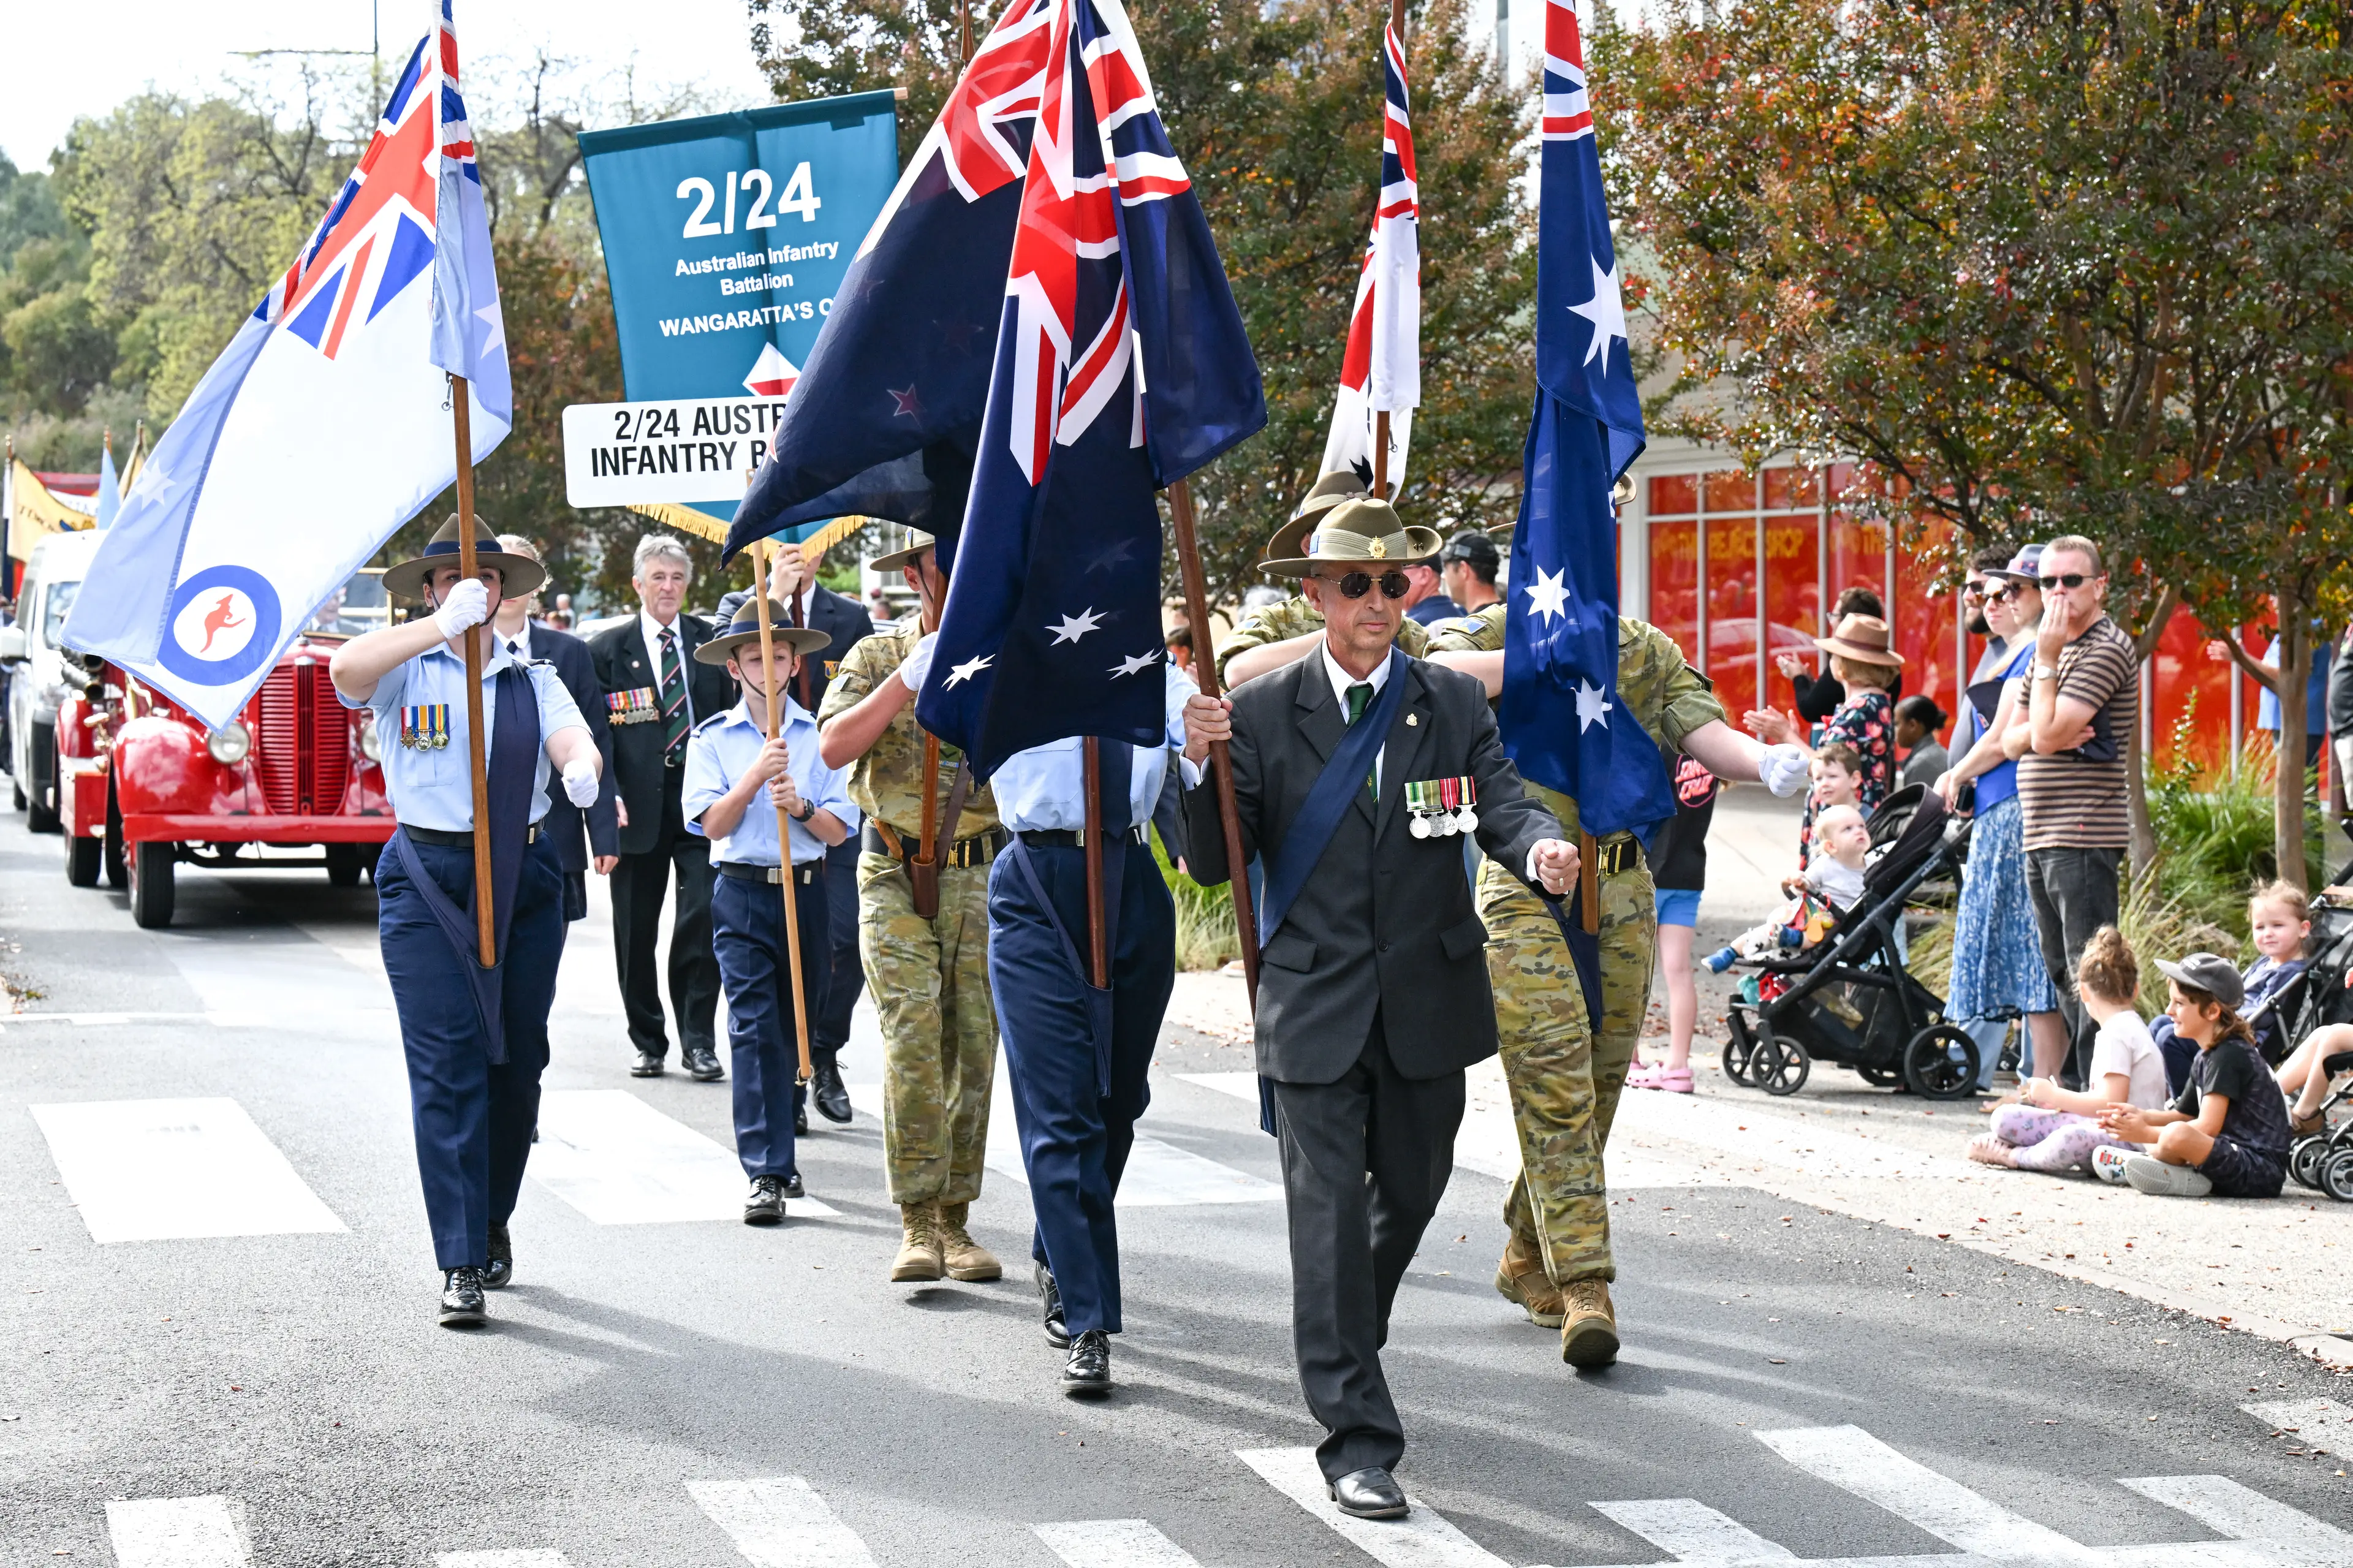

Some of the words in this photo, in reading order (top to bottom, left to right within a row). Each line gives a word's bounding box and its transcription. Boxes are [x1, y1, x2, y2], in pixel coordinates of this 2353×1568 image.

[676, 161, 822, 238] 2/24
[675, 251, 765, 276] Australian
[768, 241, 839, 265] Infantry
[720, 273, 794, 296] Battalion
[659, 301, 814, 337] WANGARATTA'S
[615, 408, 680, 442] 2/24
[591, 441, 737, 477] INFANTRY
